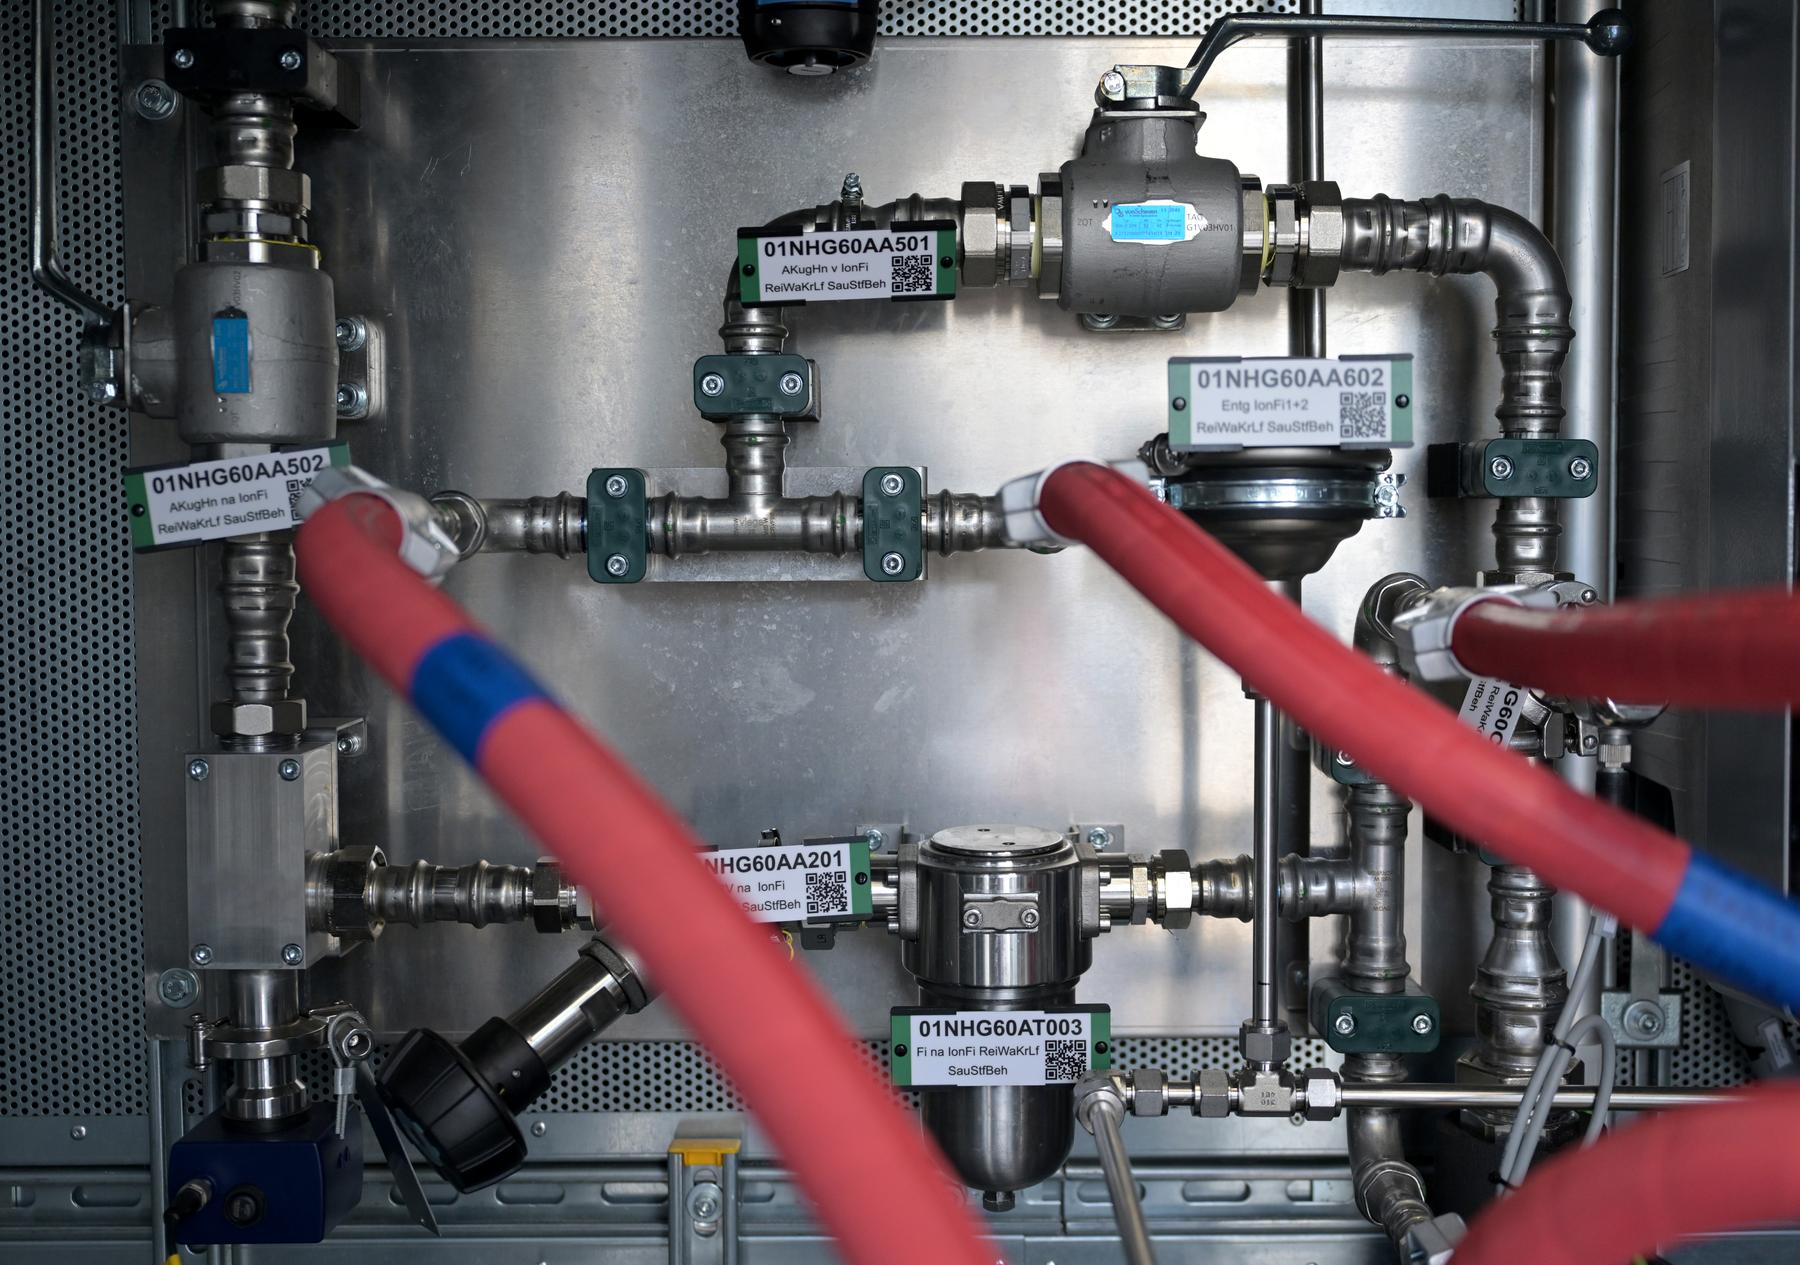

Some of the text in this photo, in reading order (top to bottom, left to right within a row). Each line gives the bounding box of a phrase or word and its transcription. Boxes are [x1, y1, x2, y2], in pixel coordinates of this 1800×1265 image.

[764, 235, 930, 258] 01NHG60AA501
[781, 262, 869, 277] AKugHn v IonFi
[765, 279, 887, 294] ReiWaKrLf SauStfBeh
[1197, 367, 1385, 389] 01NHG60AA602
[1221, 399, 1309, 413] Entg IonFi1+2
[1196, 420, 1334, 434] ReiWaKrLf SauStfBeh
[152, 454, 324, 494] 01NHG60AA502
[169, 489, 269, 513] AKugHn na IonFi
[158, 507, 286, 535] ReiWaKrLf SauStfBeh
[704, 850, 843, 875] NHG60AA201
[737, 883, 751, 893] na
[757, 880, 786, 893] IonFi
[741, 899, 802, 913] SauStfBeh
[919, 1018, 1083, 1037] 01NHG60AT003
[916, 1045, 1040, 1057] Fi na IonFi ReiWaKrLf
[948, 1065, 1008, 1076] SauStfBeh
